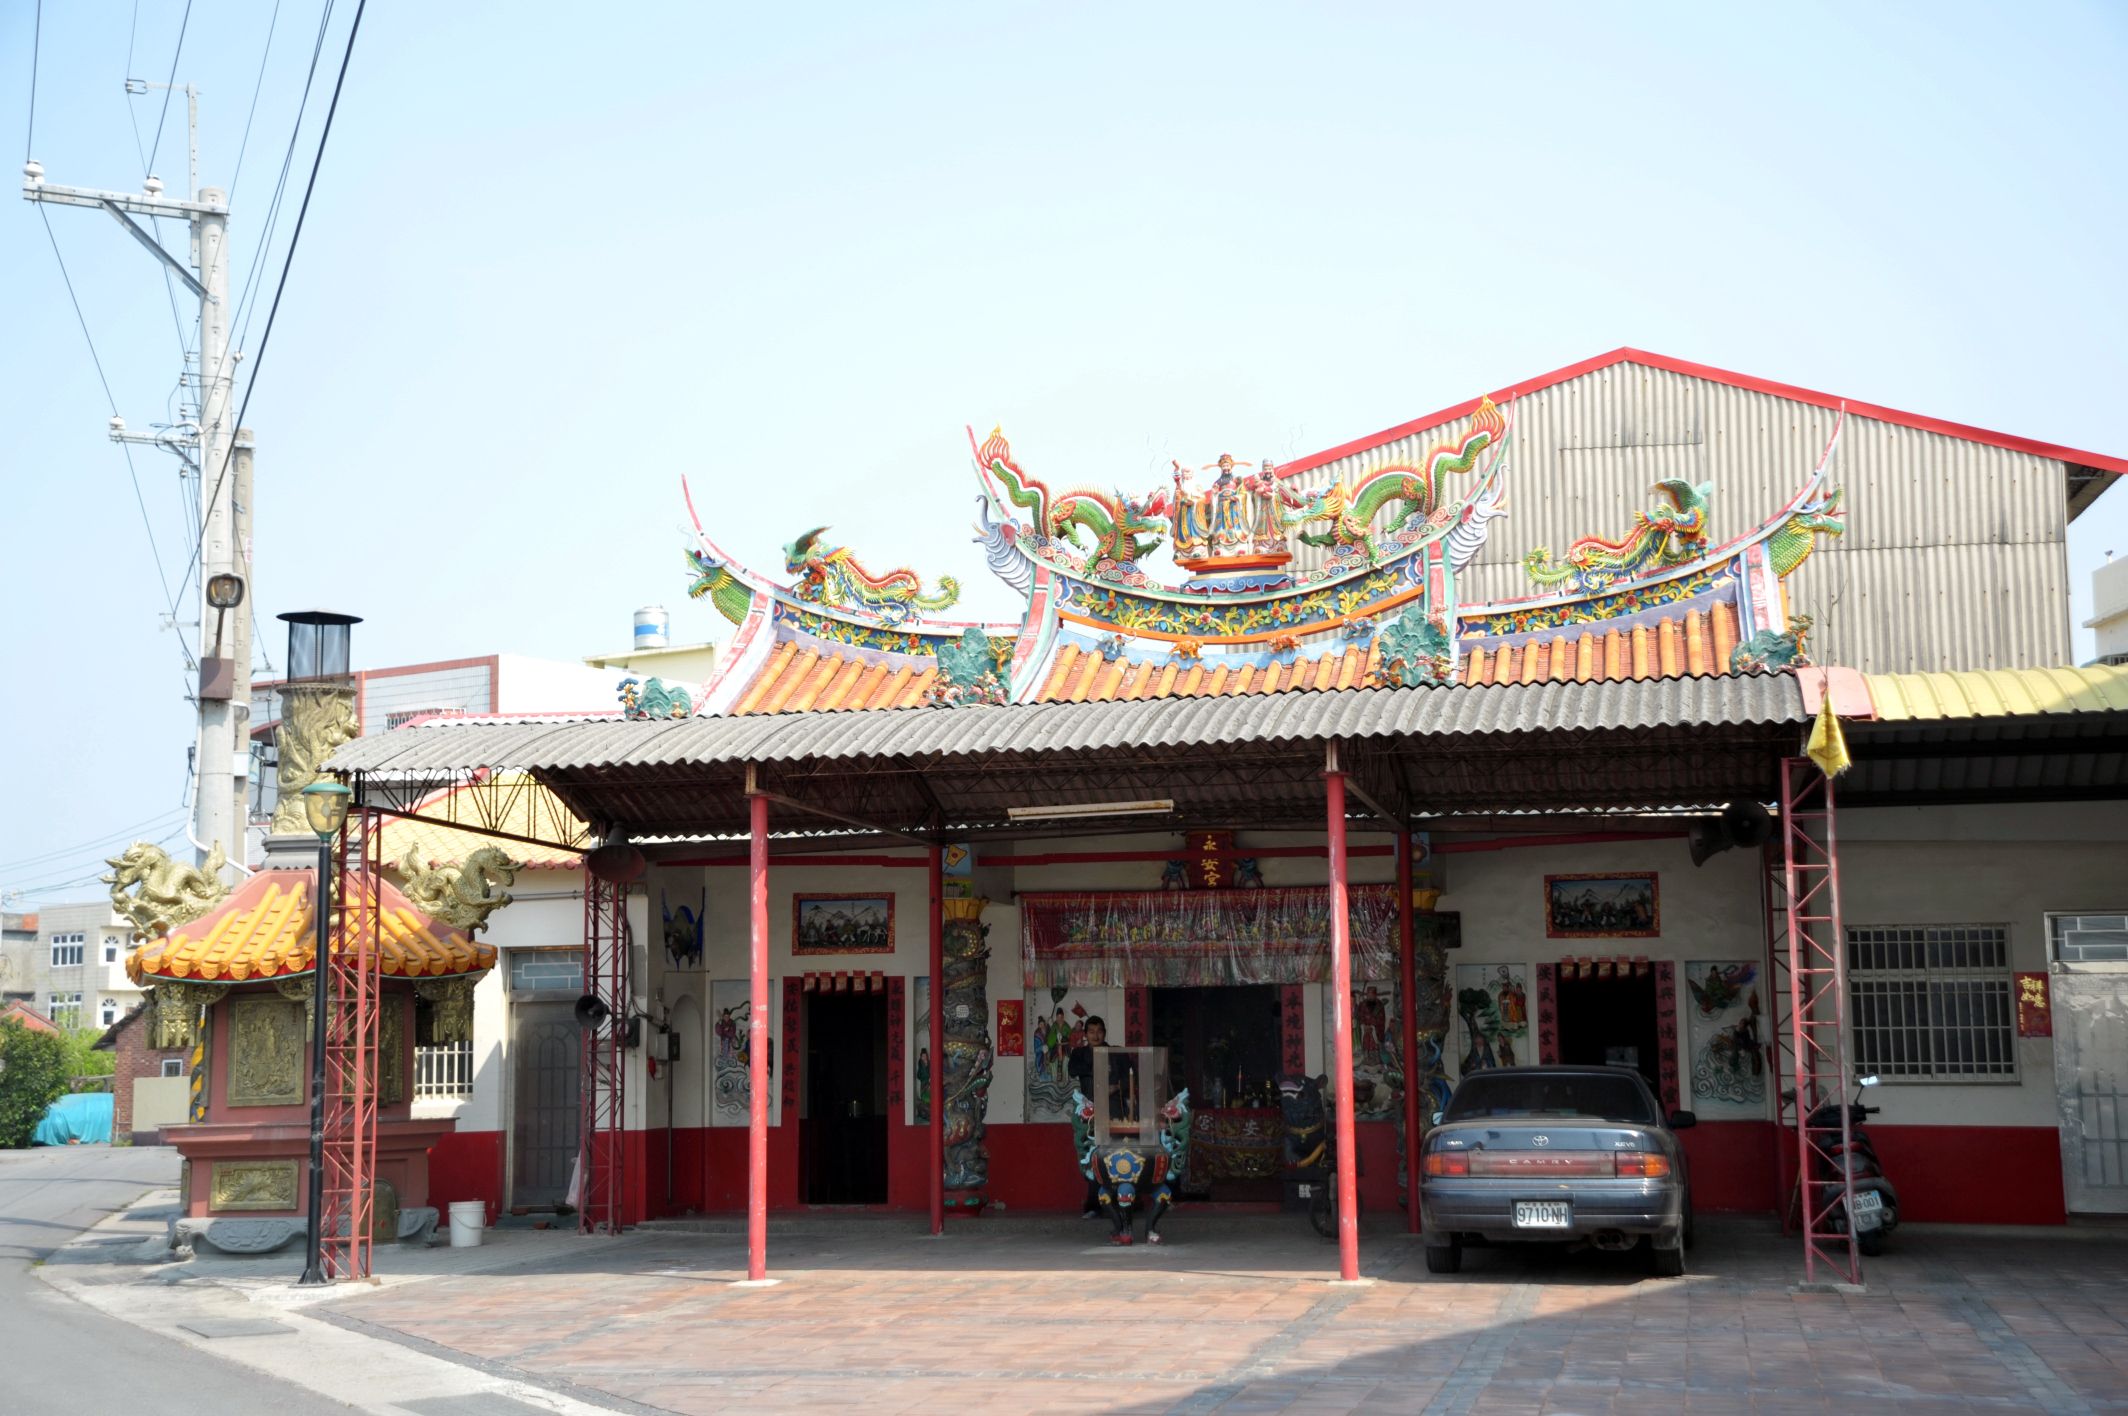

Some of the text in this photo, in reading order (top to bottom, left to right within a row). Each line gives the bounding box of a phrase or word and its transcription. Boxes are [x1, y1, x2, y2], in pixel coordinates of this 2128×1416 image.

[1200, 834, 1221, 888] 永安宮
[2019, 975, 2044, 993] 吉祥
[1518, 1207, 1568, 1223] 9710-NH
